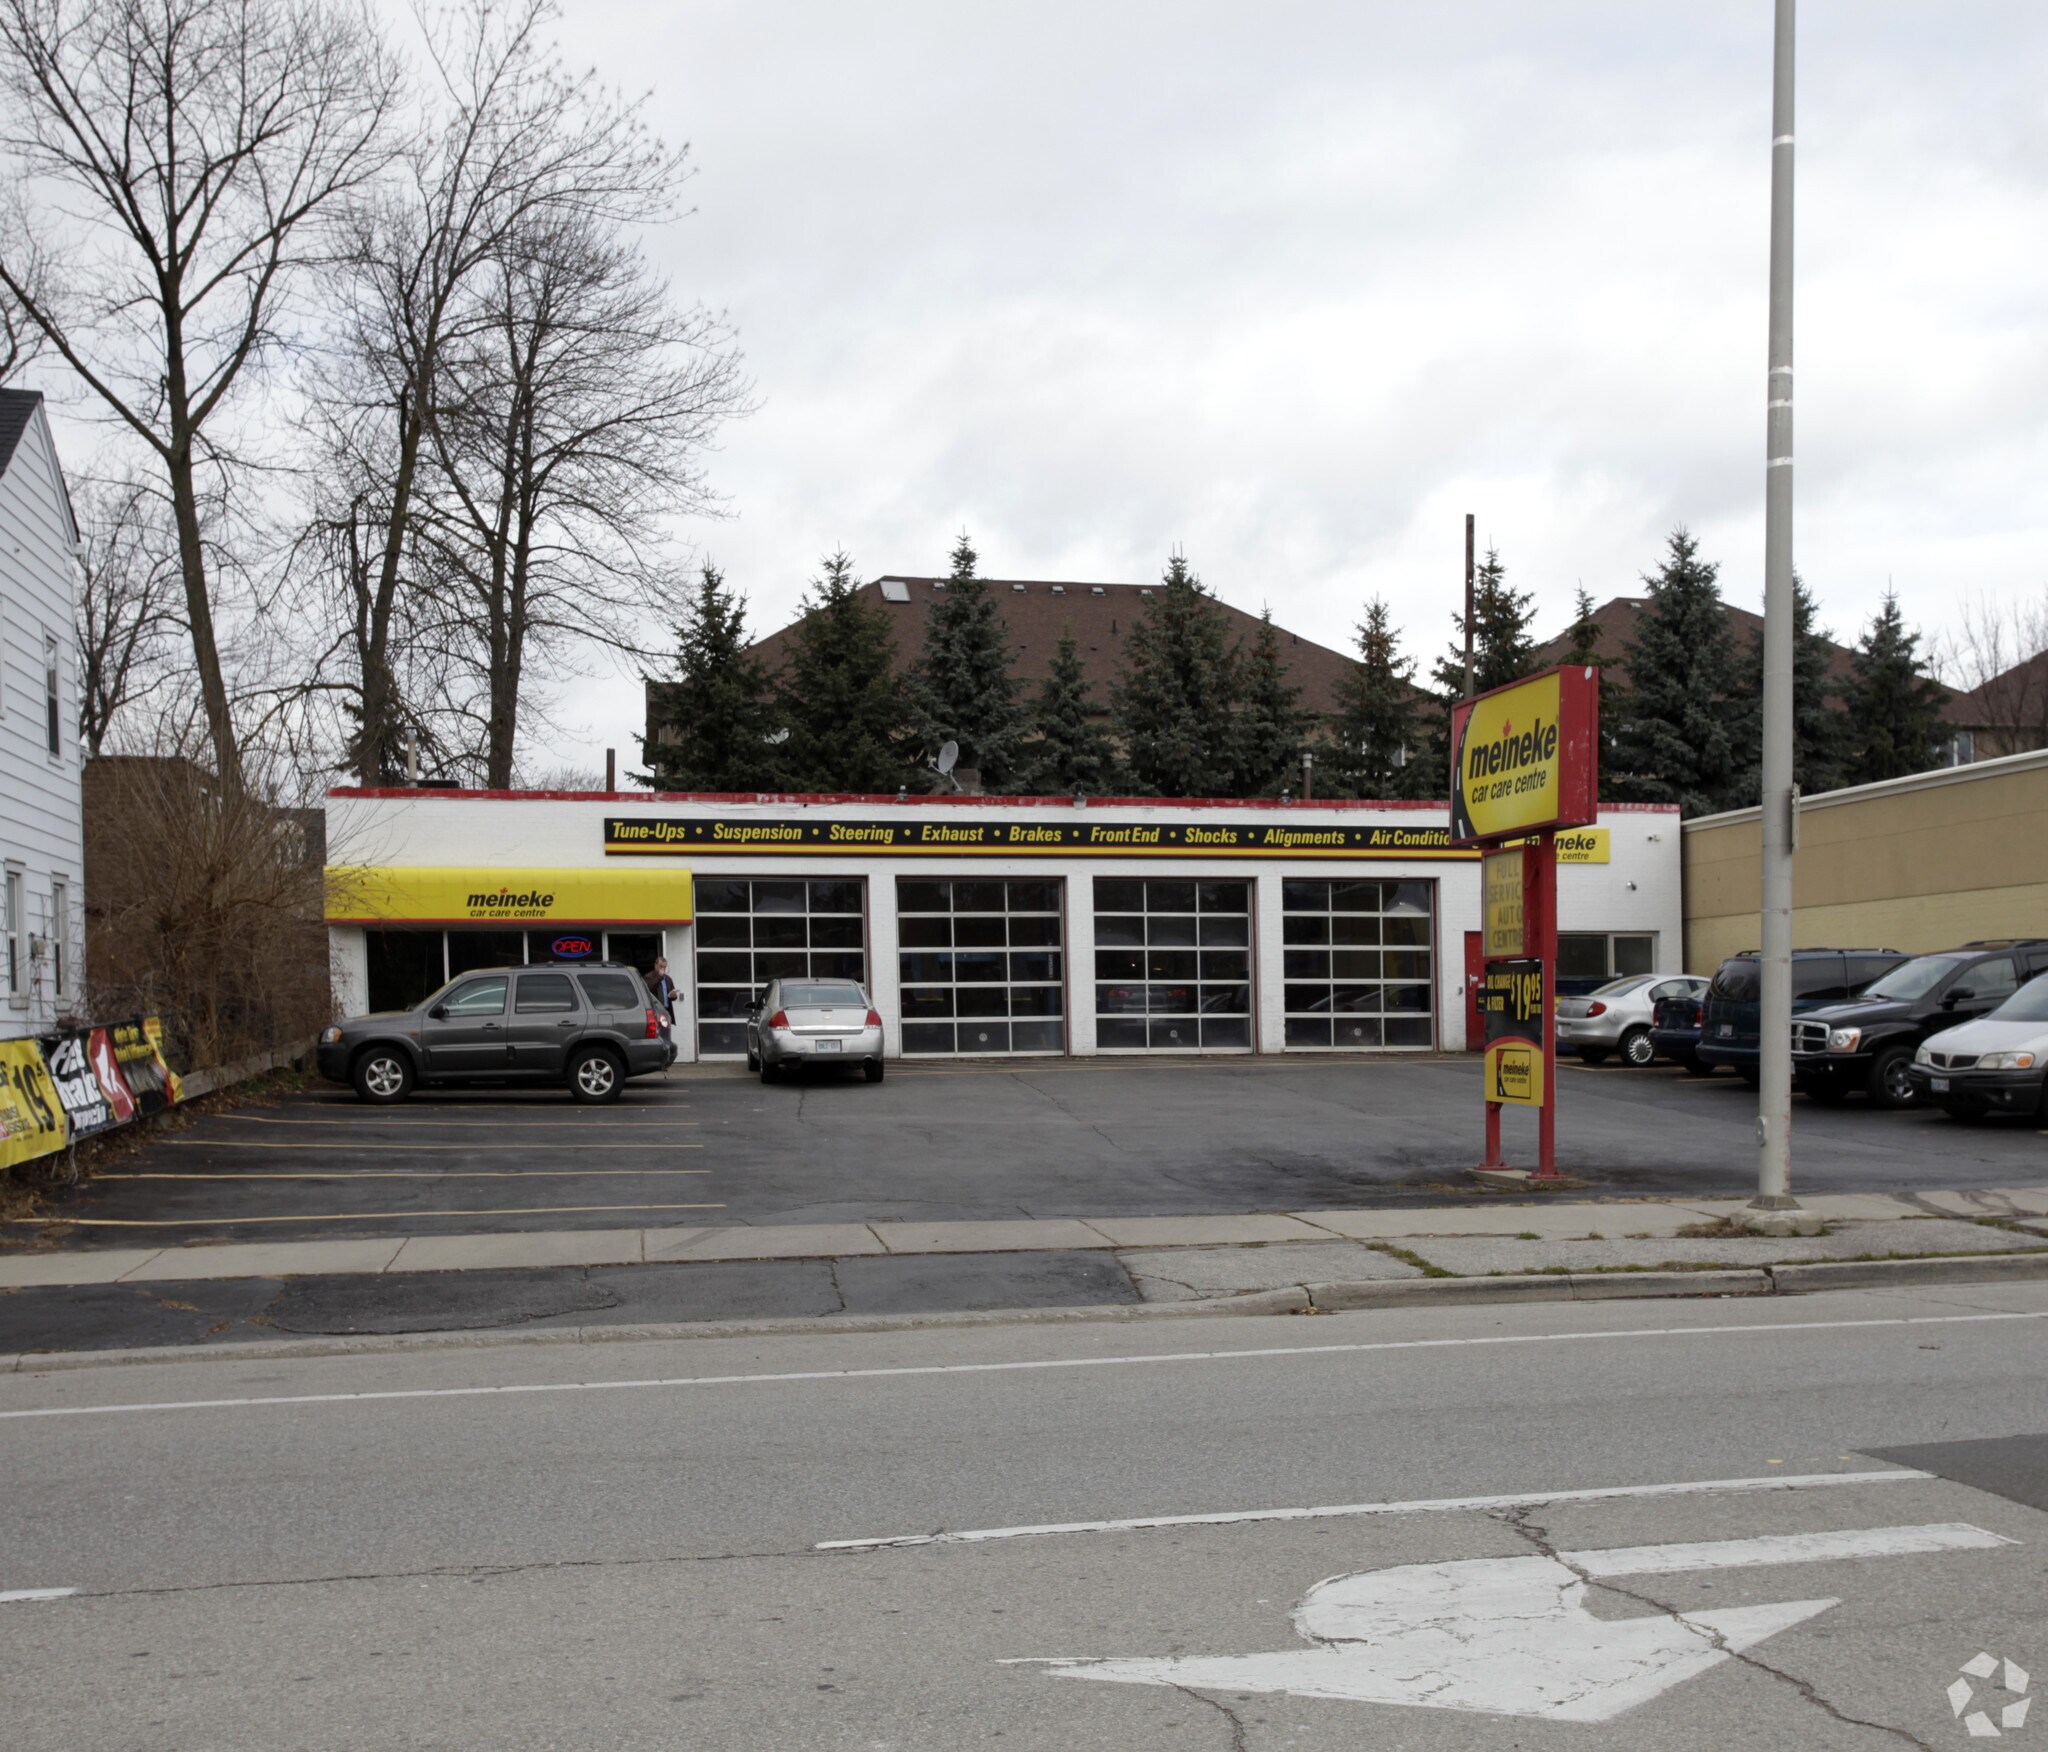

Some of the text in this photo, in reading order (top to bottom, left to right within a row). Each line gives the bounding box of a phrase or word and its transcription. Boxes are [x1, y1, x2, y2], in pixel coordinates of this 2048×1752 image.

[1469, 718, 1557, 779] meineke
[1472, 768, 1546, 804] car care centre
[613, 822, 1449, 847] Tune-Ups Suspension Steering Exhaust Brakes Front End Shocks Alignments Air Conditio
[1562, 852, 1589, 860] centre
[1496, 861, 1519, 879] FULL
[467, 890, 554, 907] meineke
[1488, 881, 1521, 903] SERVIC
[470, 908, 546, 917] car care centre
[1498, 904, 1523, 926] AUTO
[553, 941, 591, 953] OPEN
[1492, 928, 1523, 949] CENTRE
